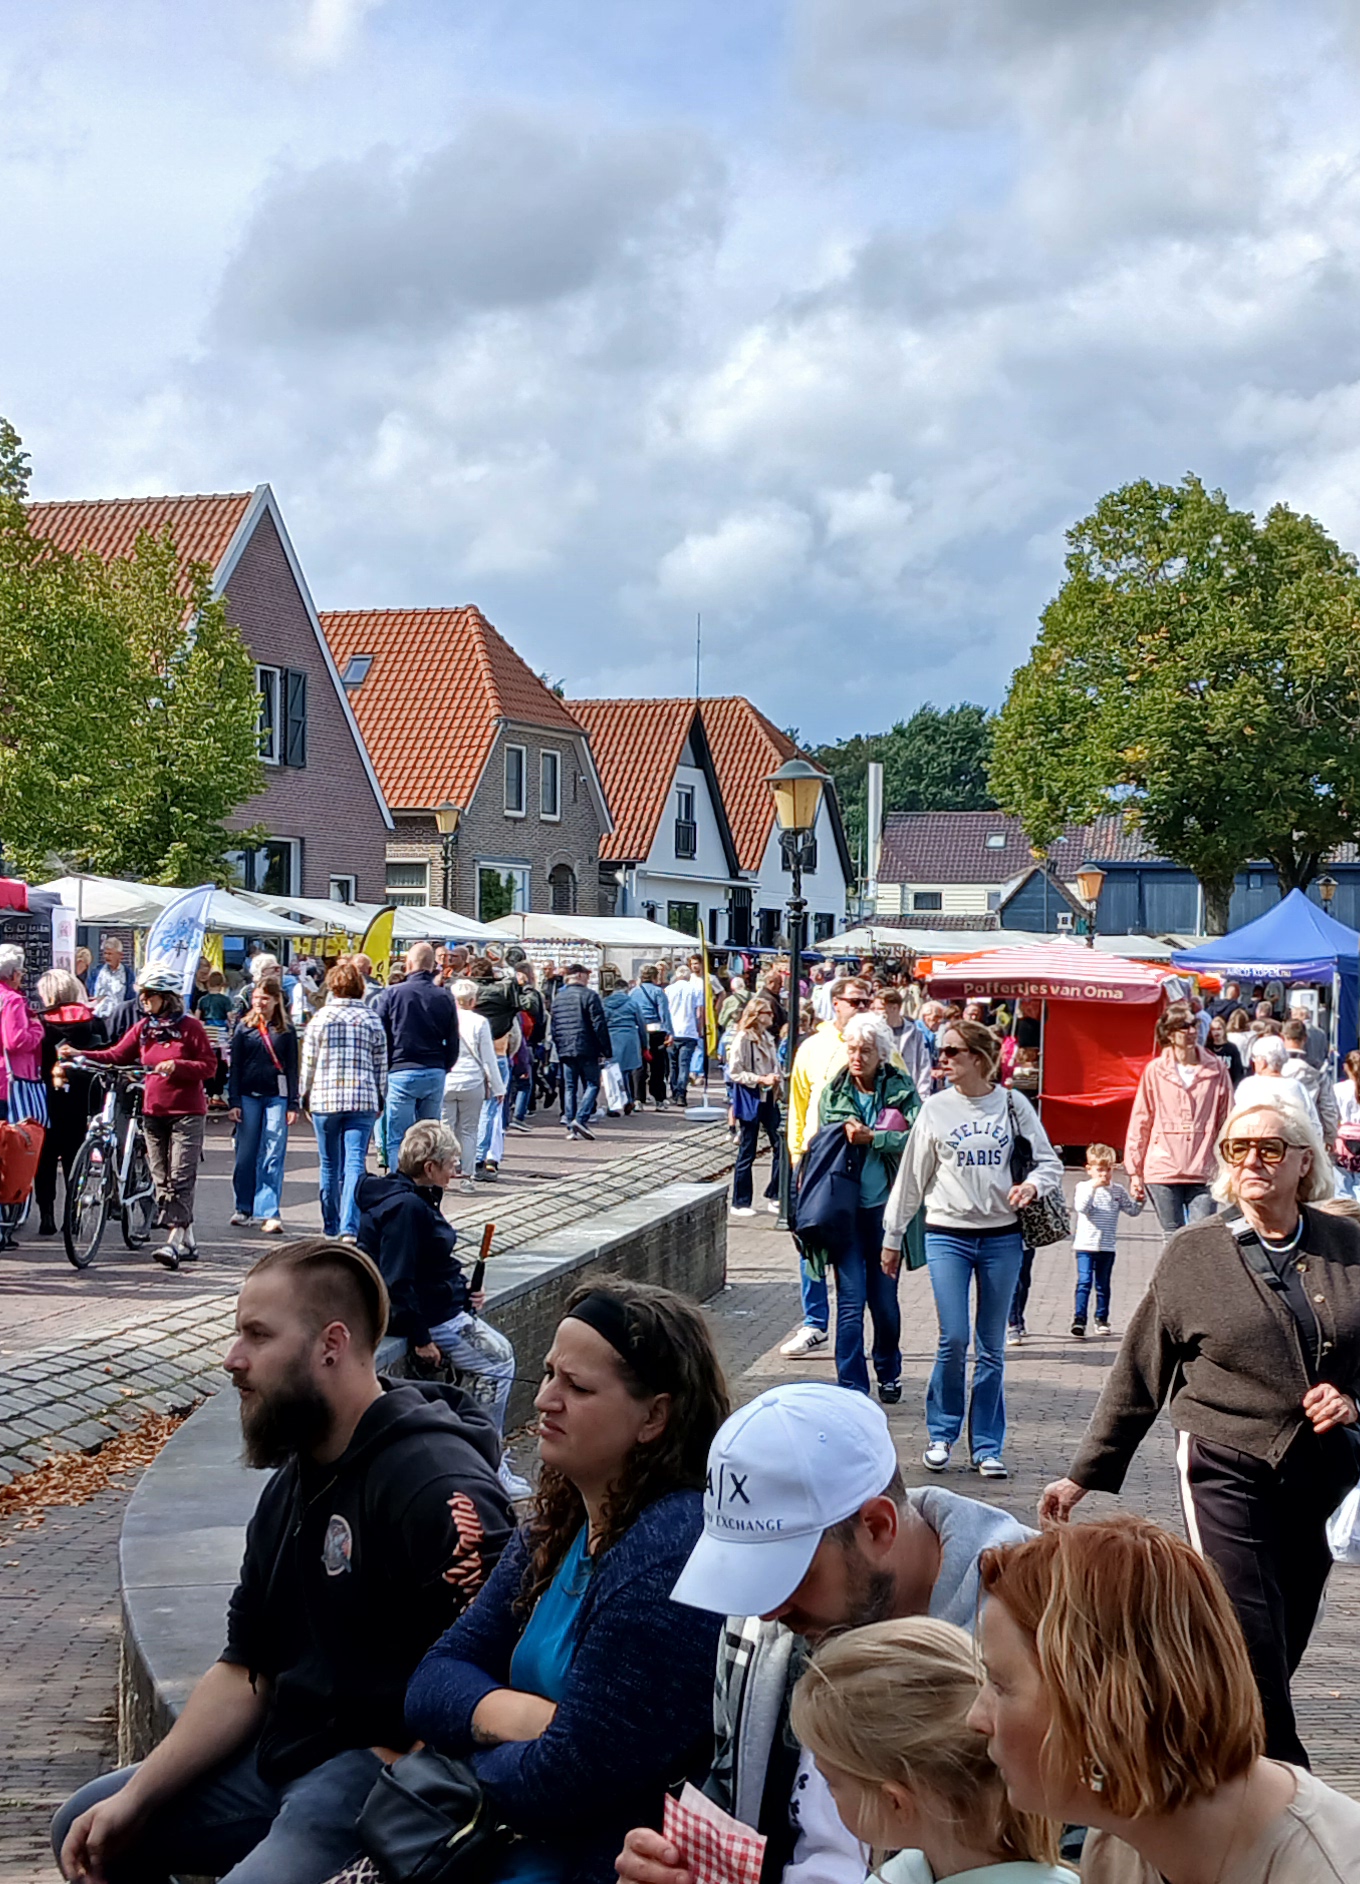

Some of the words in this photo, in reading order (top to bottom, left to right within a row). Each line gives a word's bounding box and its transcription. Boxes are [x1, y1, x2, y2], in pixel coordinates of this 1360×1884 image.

[964, 982, 1048, 996] Poffertjes
[1050, 985, 1081, 998] van
[1084, 985, 1124, 1000] Oma
[945, 1121, 1009, 1150] ATELIER
[957, 1150, 1001, 1167] PARIS
[716, 1515, 784, 1532] EXCHANGE
